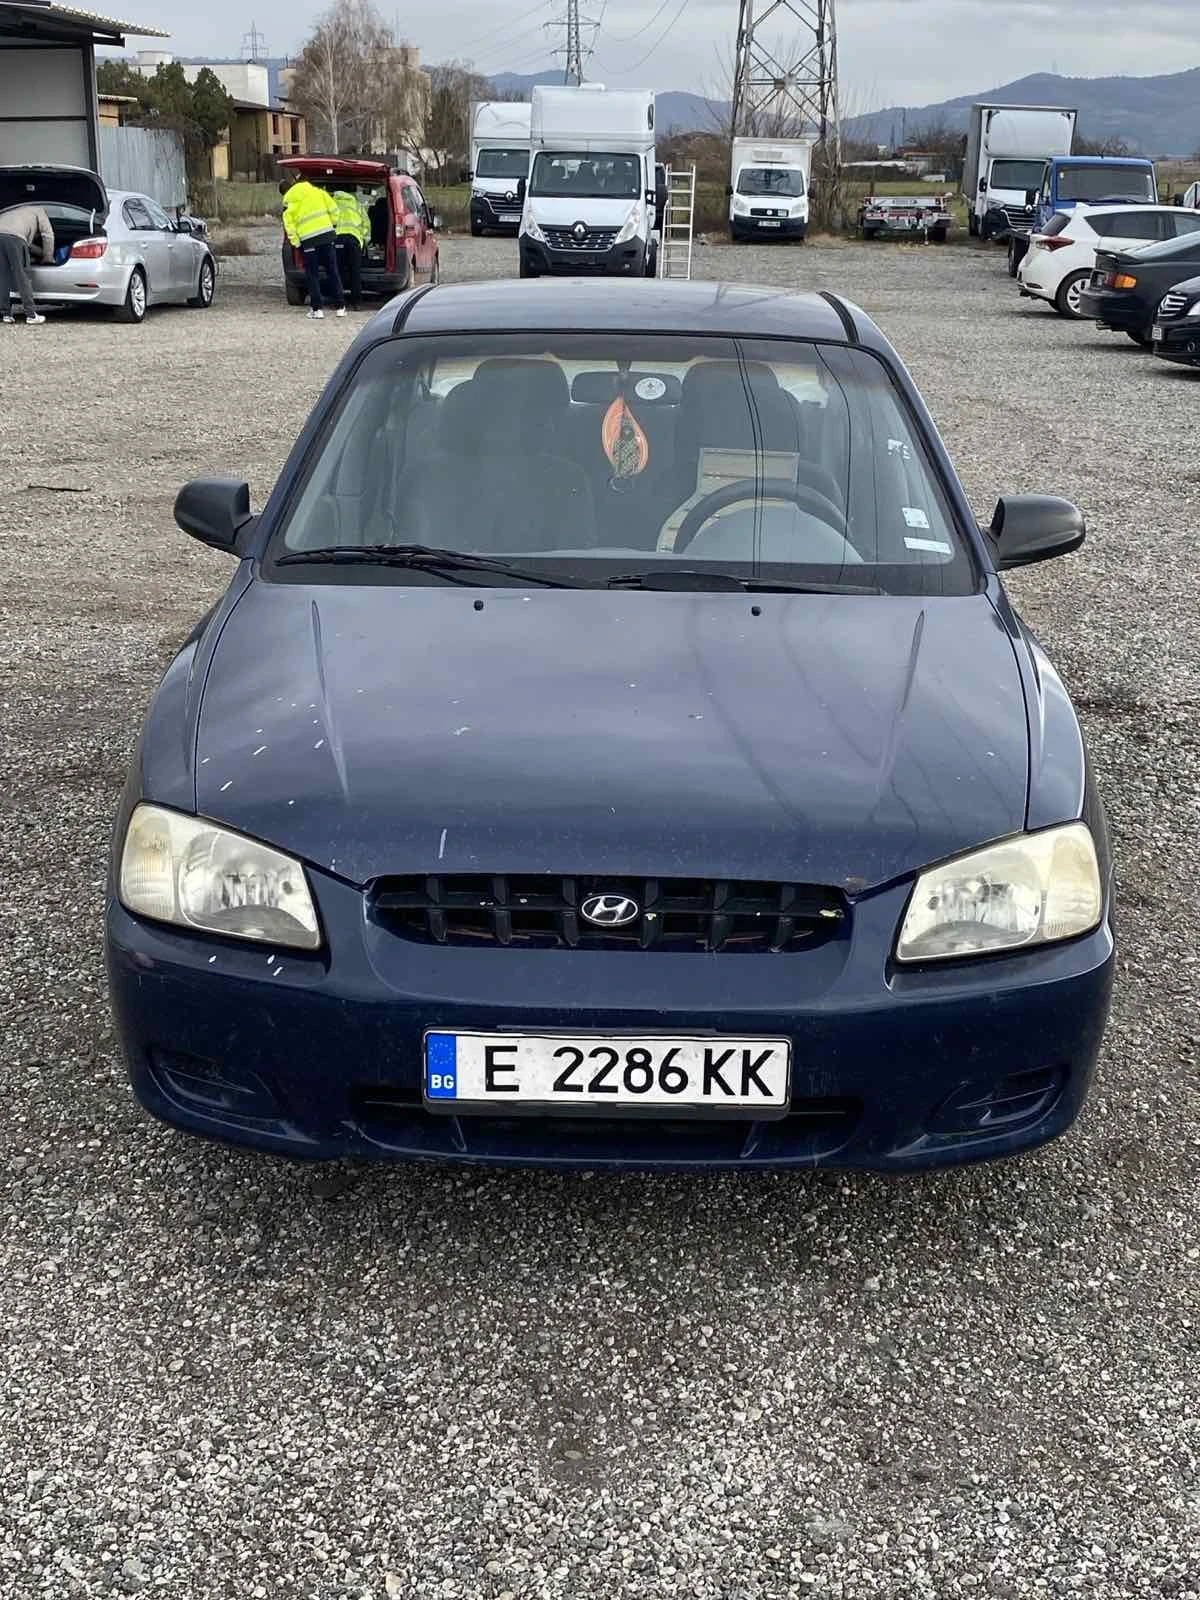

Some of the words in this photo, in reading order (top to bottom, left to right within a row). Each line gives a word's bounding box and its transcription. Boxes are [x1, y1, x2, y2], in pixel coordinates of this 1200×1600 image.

[430, 1074, 455, 1090] BG
[485, 1046, 519, 1092] E
[552, 1046, 689, 1095] 2286
